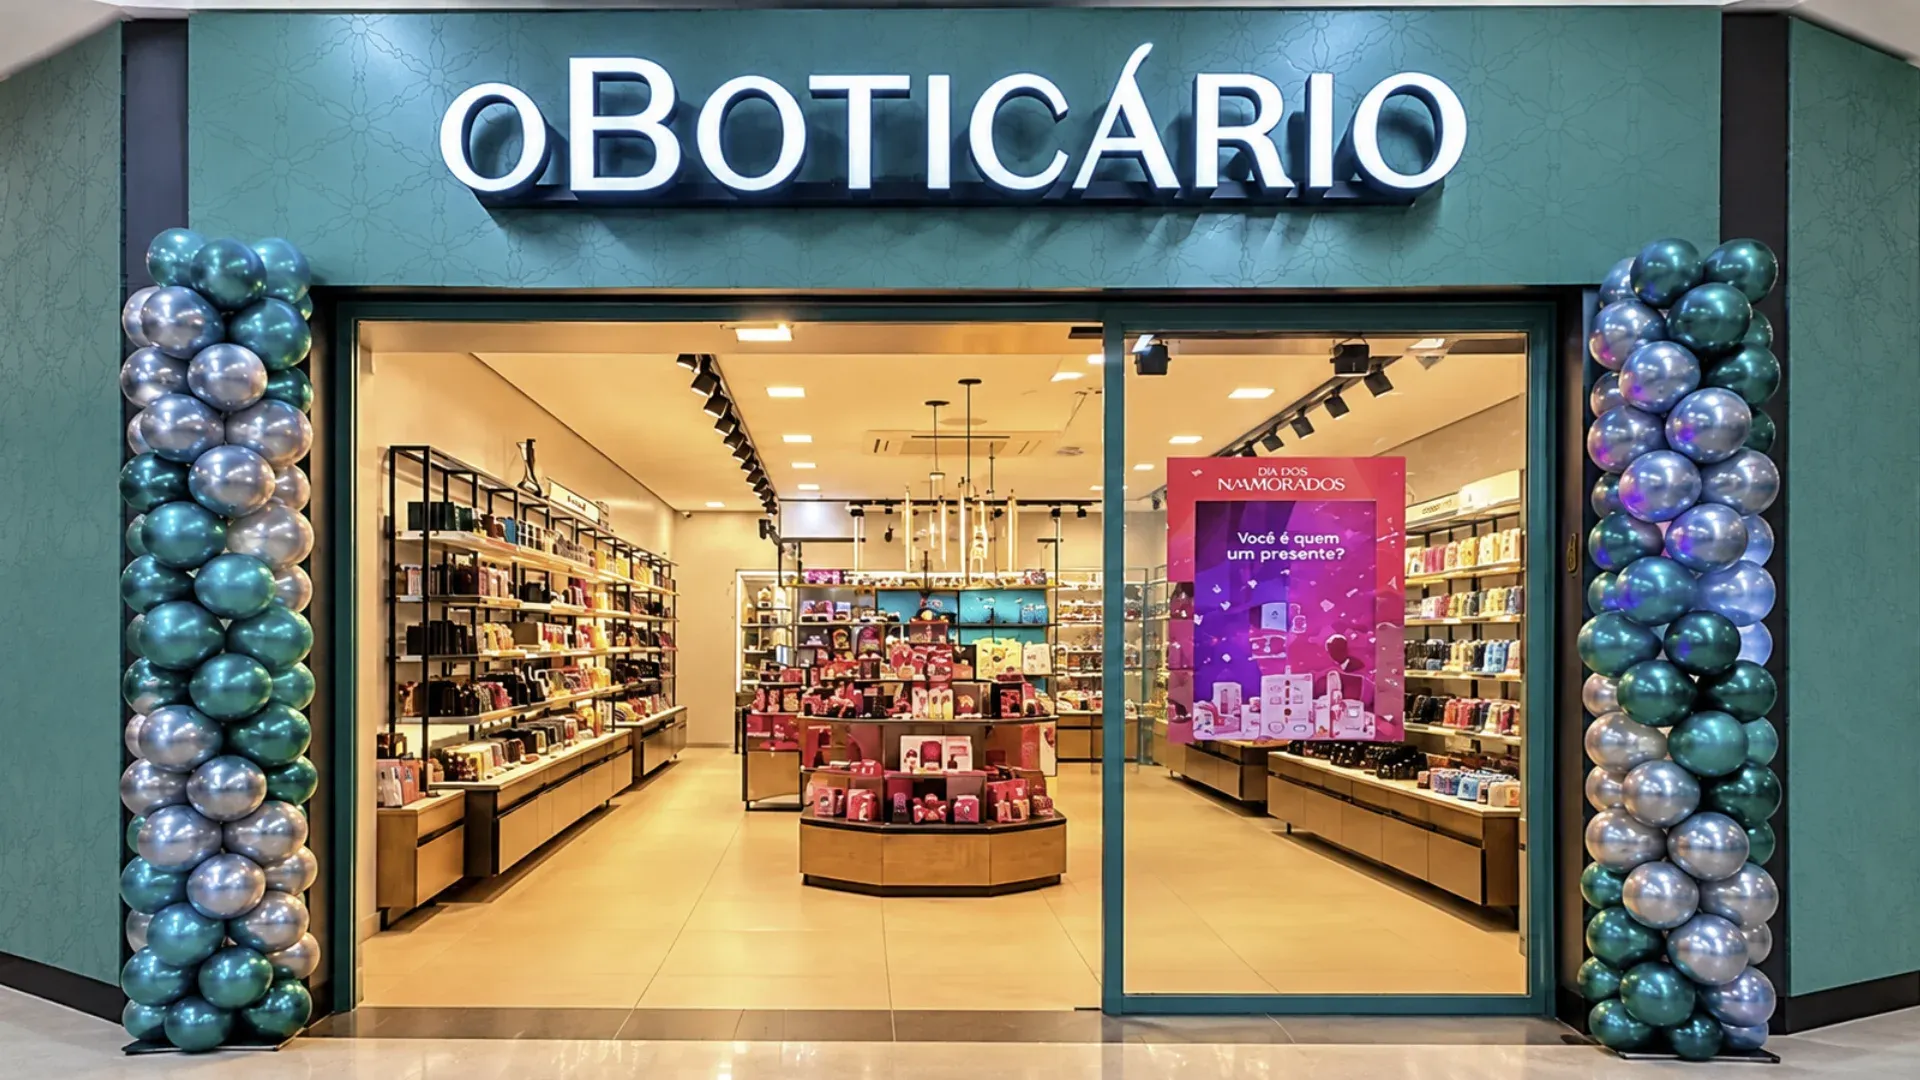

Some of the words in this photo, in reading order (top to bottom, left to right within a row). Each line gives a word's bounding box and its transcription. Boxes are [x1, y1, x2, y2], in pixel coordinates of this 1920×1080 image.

[1258, 467, 1277, 476] DIA
[1281, 467, 1308, 476] DOS
[1218, 478, 1345, 491] NAMORADOS
[1237, 531, 1275, 544] Você
[1280, 531, 1289, 544] é
[1294, 534, 1339, 547] quem
[1227, 549, 1255, 560] um
[1260, 548, 1345, 562] presente?
